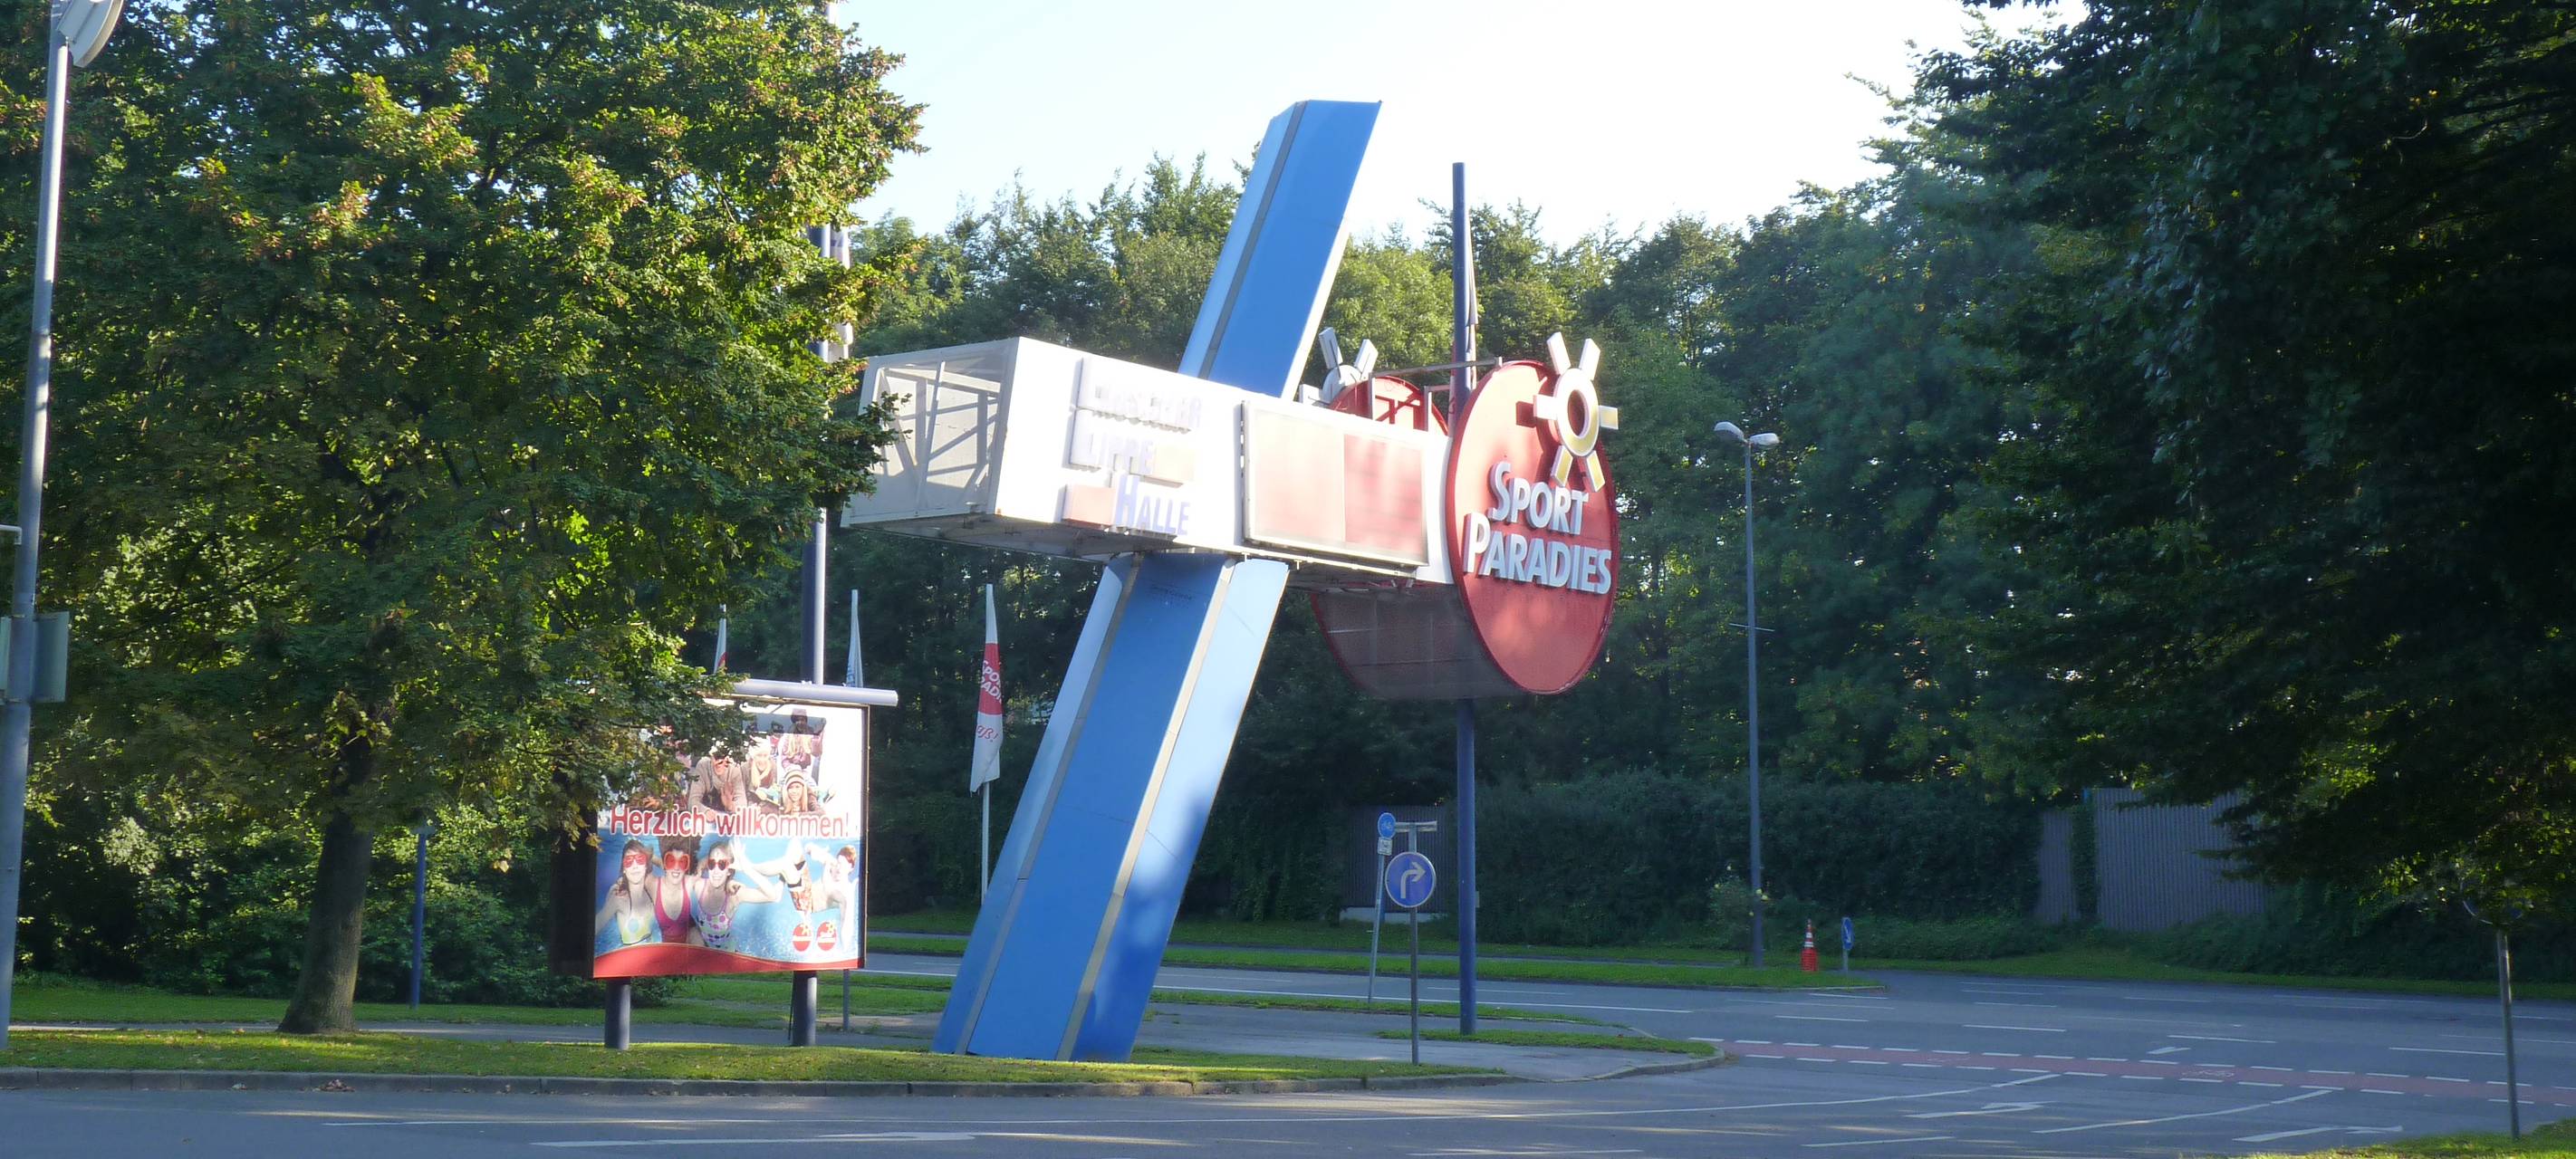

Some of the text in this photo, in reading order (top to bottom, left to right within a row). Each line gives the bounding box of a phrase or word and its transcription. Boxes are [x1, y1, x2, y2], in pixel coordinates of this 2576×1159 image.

[1114, 474, 1190, 536] HALLE
[1487, 462, 1589, 535] SPORT
[1464, 512, 1612, 595] PARADIES
[610, 805, 849, 838] Herzlich willkommen!
